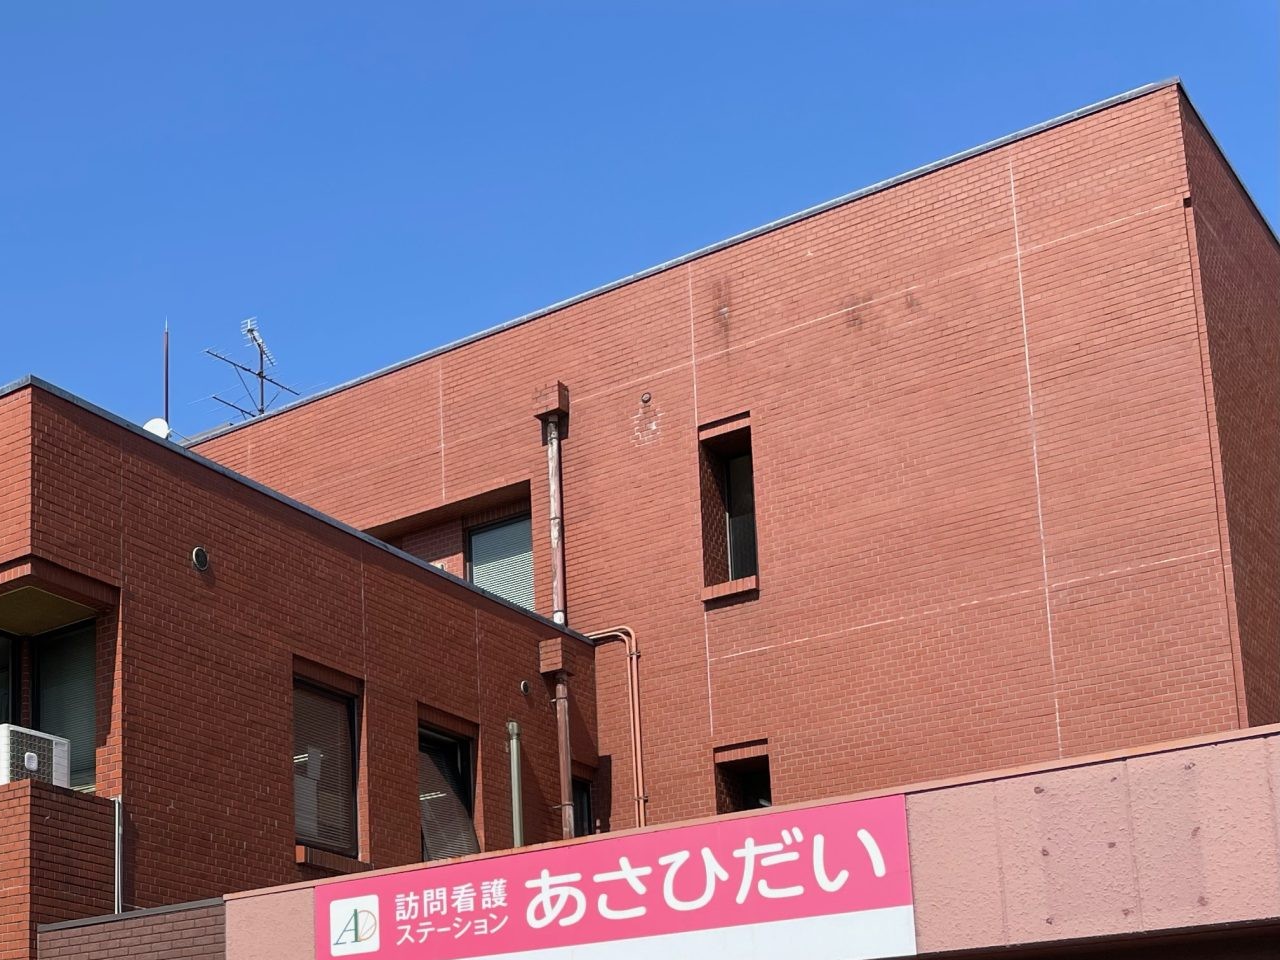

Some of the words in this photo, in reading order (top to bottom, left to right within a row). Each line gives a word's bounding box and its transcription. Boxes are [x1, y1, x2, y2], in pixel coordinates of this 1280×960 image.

[524, 826, 887, 929] あさひだい
[394, 878, 508, 922] 訪問看護
[395, 912, 509, 946] ステーション
